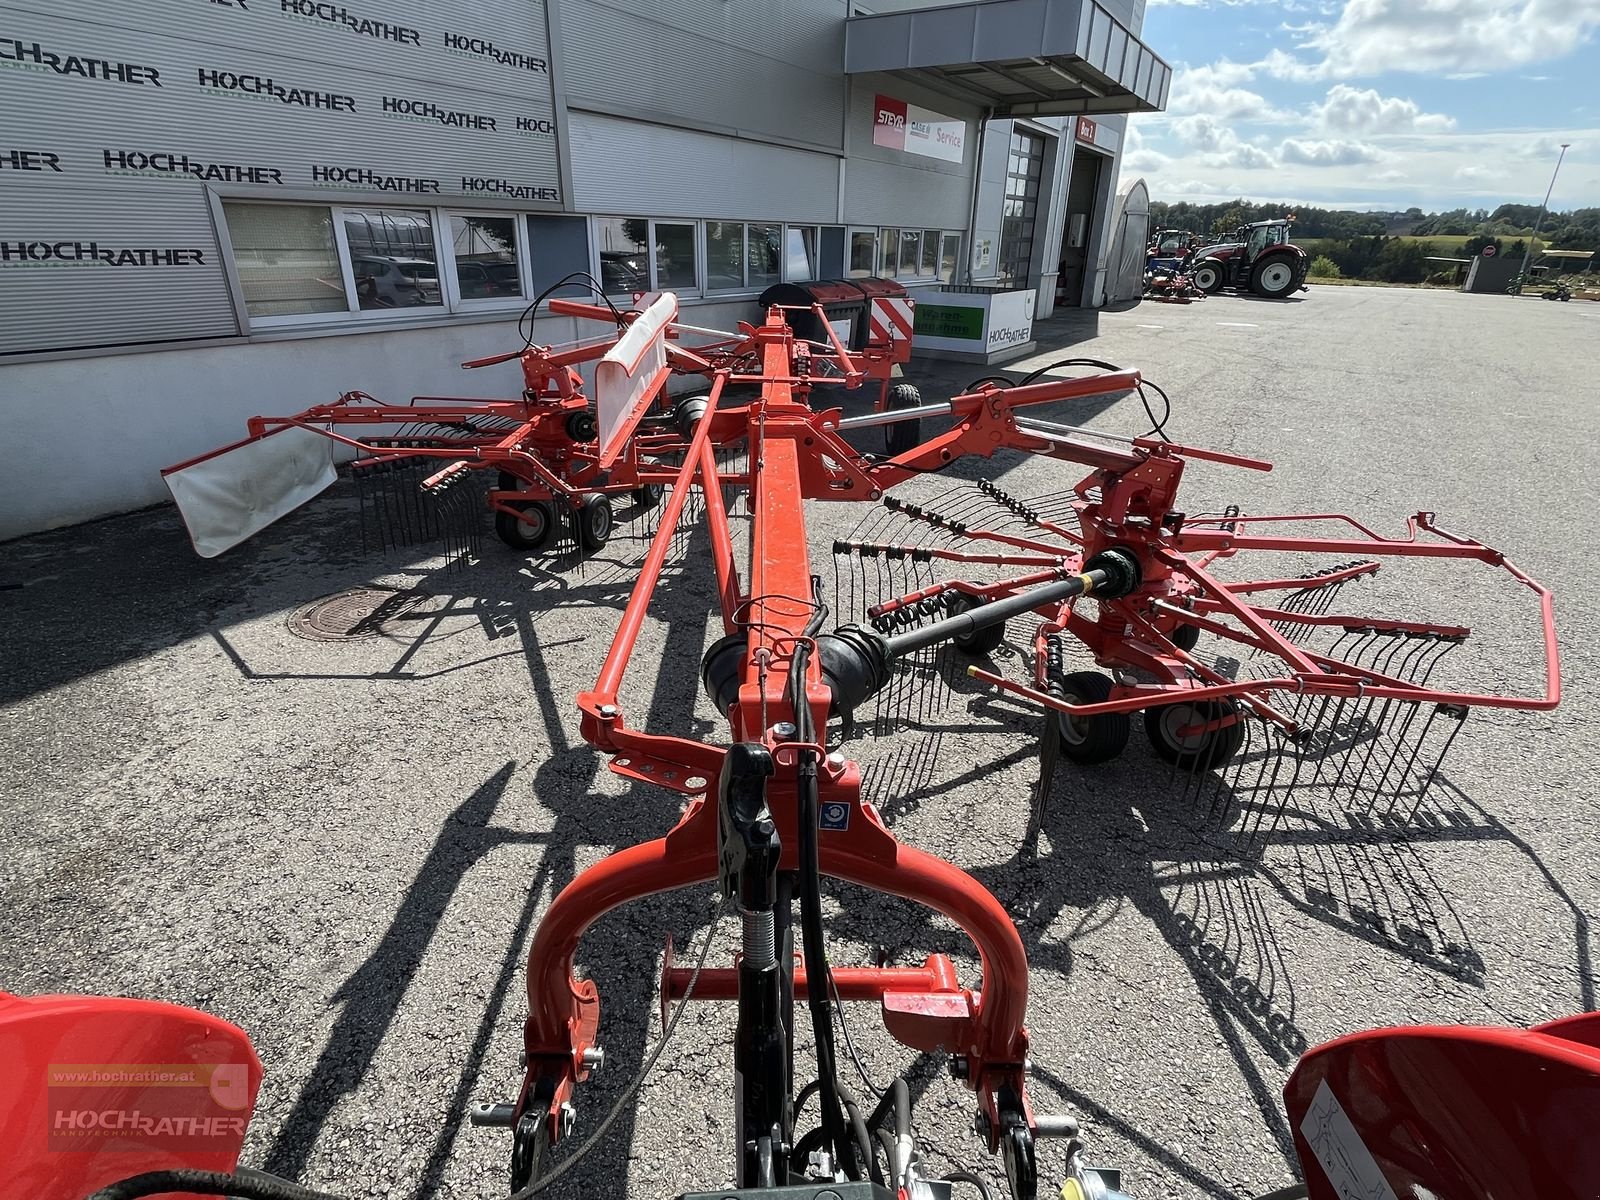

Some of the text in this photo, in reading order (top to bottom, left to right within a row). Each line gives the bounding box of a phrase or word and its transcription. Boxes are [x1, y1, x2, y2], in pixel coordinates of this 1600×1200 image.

[281, 0, 421, 46] HOCHRATHER
[444, 32, 547, 73] HOCHRATHER
[198, 68, 356, 112] HOCHRATHER
[382, 96, 496, 131] HOCHRATHER
[878, 110, 904, 128] STEYR
[937, 127, 961, 148] Service
[104, 150, 283, 184] HOCHRATHER
[312, 166, 440, 193] HOCHRATHER
[461, 177, 557, 200] HOCHRATHER
[1, 242, 206, 266] HOCHRATHER
[989, 327, 1029, 343] HOCHRATHER
